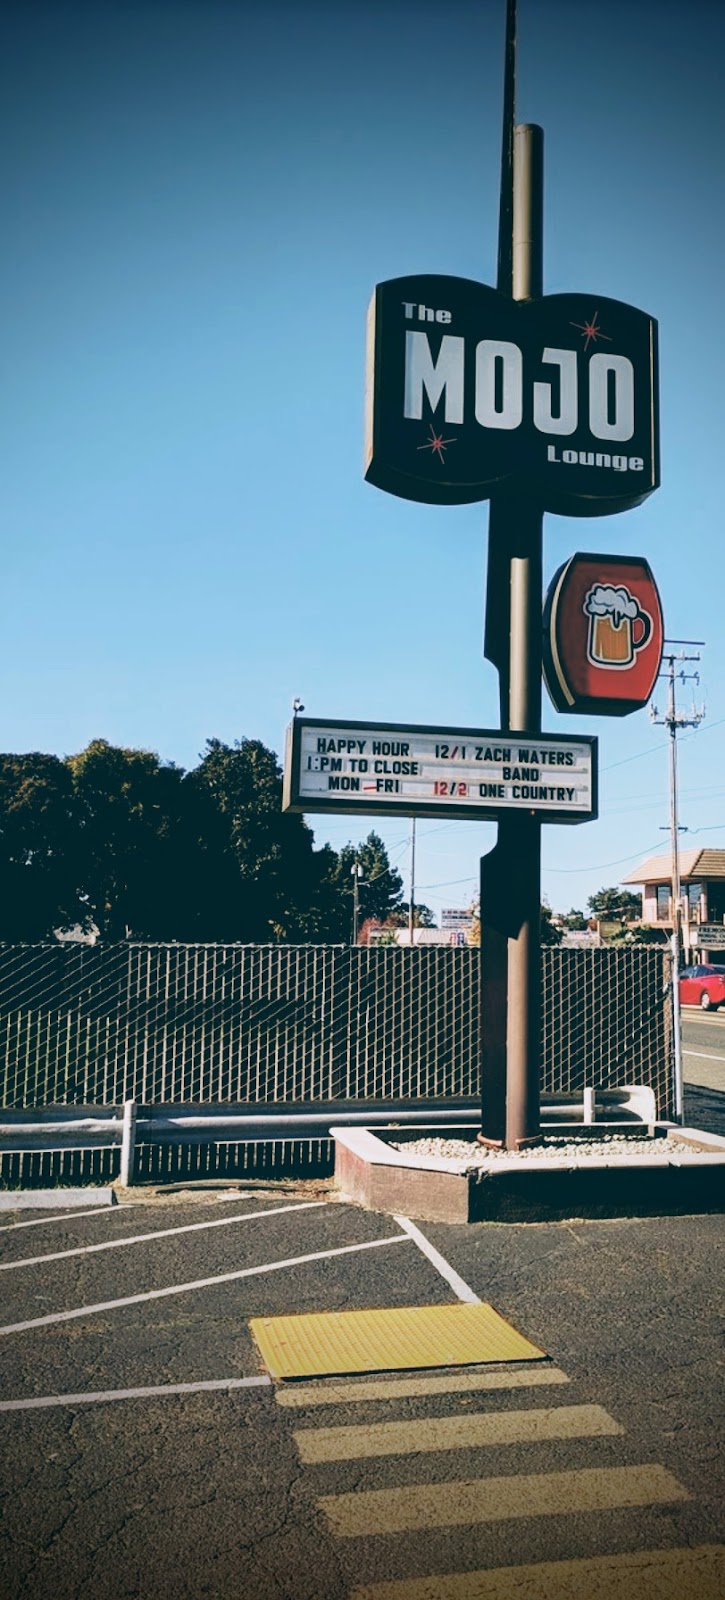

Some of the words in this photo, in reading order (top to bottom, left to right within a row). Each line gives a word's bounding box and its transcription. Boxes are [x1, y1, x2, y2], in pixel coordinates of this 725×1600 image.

[402, 302, 452, 324] The
[403, 330, 635, 442] MOJO
[547, 445, 644, 472] Lounge
[317, 738, 366, 754] HAPPY
[372, 741, 410, 756] HOUR
[435, 744, 466, 759] 12/1
[475, 747, 511, 762] ZACH
[518, 749, 574, 766] WATERS
[307, 756, 342, 772] 1:PM
[349, 759, 368, 773] TO
[374, 760, 419, 775] CLOSE
[503, 767, 539, 782] BAND
[328, 776, 360, 791] MON
[433, 782, 467, 796] 12/2
[479, 783, 505, 798] ONE
[512, 785, 575, 801] COUNTRY
